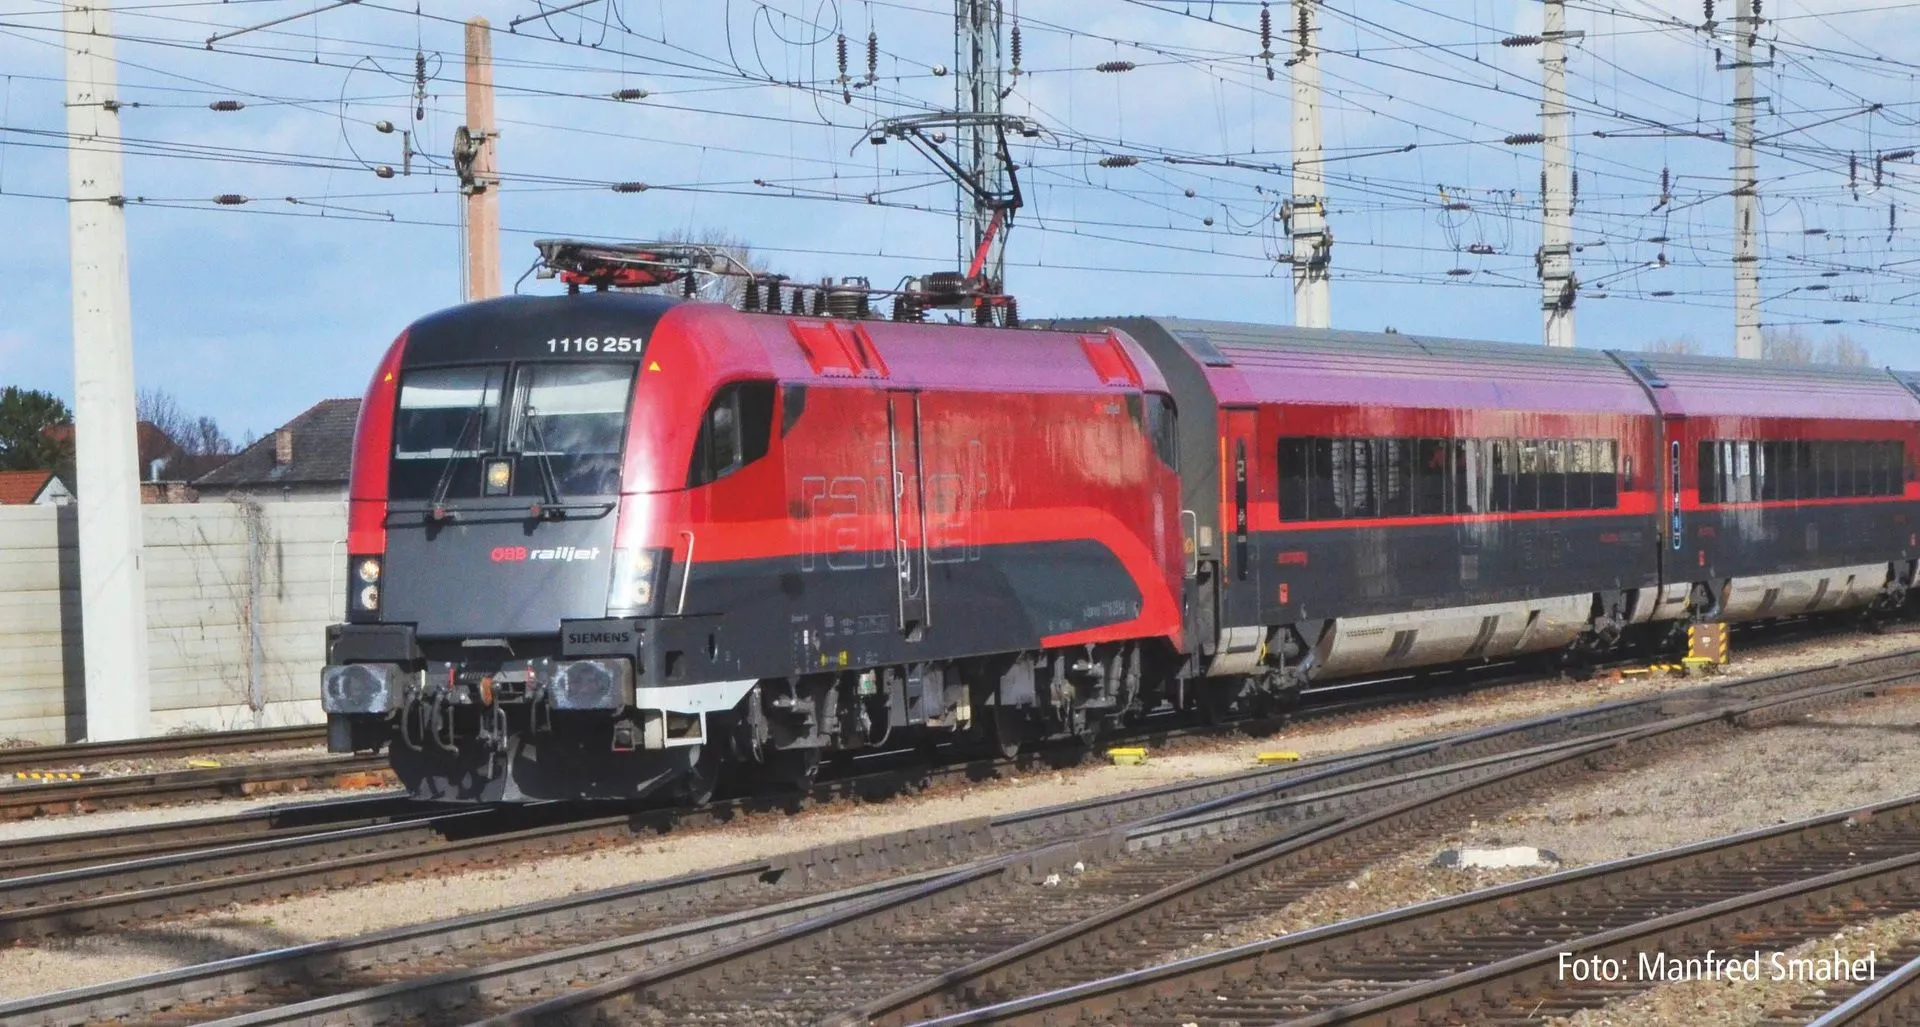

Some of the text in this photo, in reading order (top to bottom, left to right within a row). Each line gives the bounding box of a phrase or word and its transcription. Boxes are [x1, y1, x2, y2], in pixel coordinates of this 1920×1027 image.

[547, 336, 643, 353] 1116 251
[530, 546, 600, 562] railjet
[568, 631, 630, 644] SIEMENS
